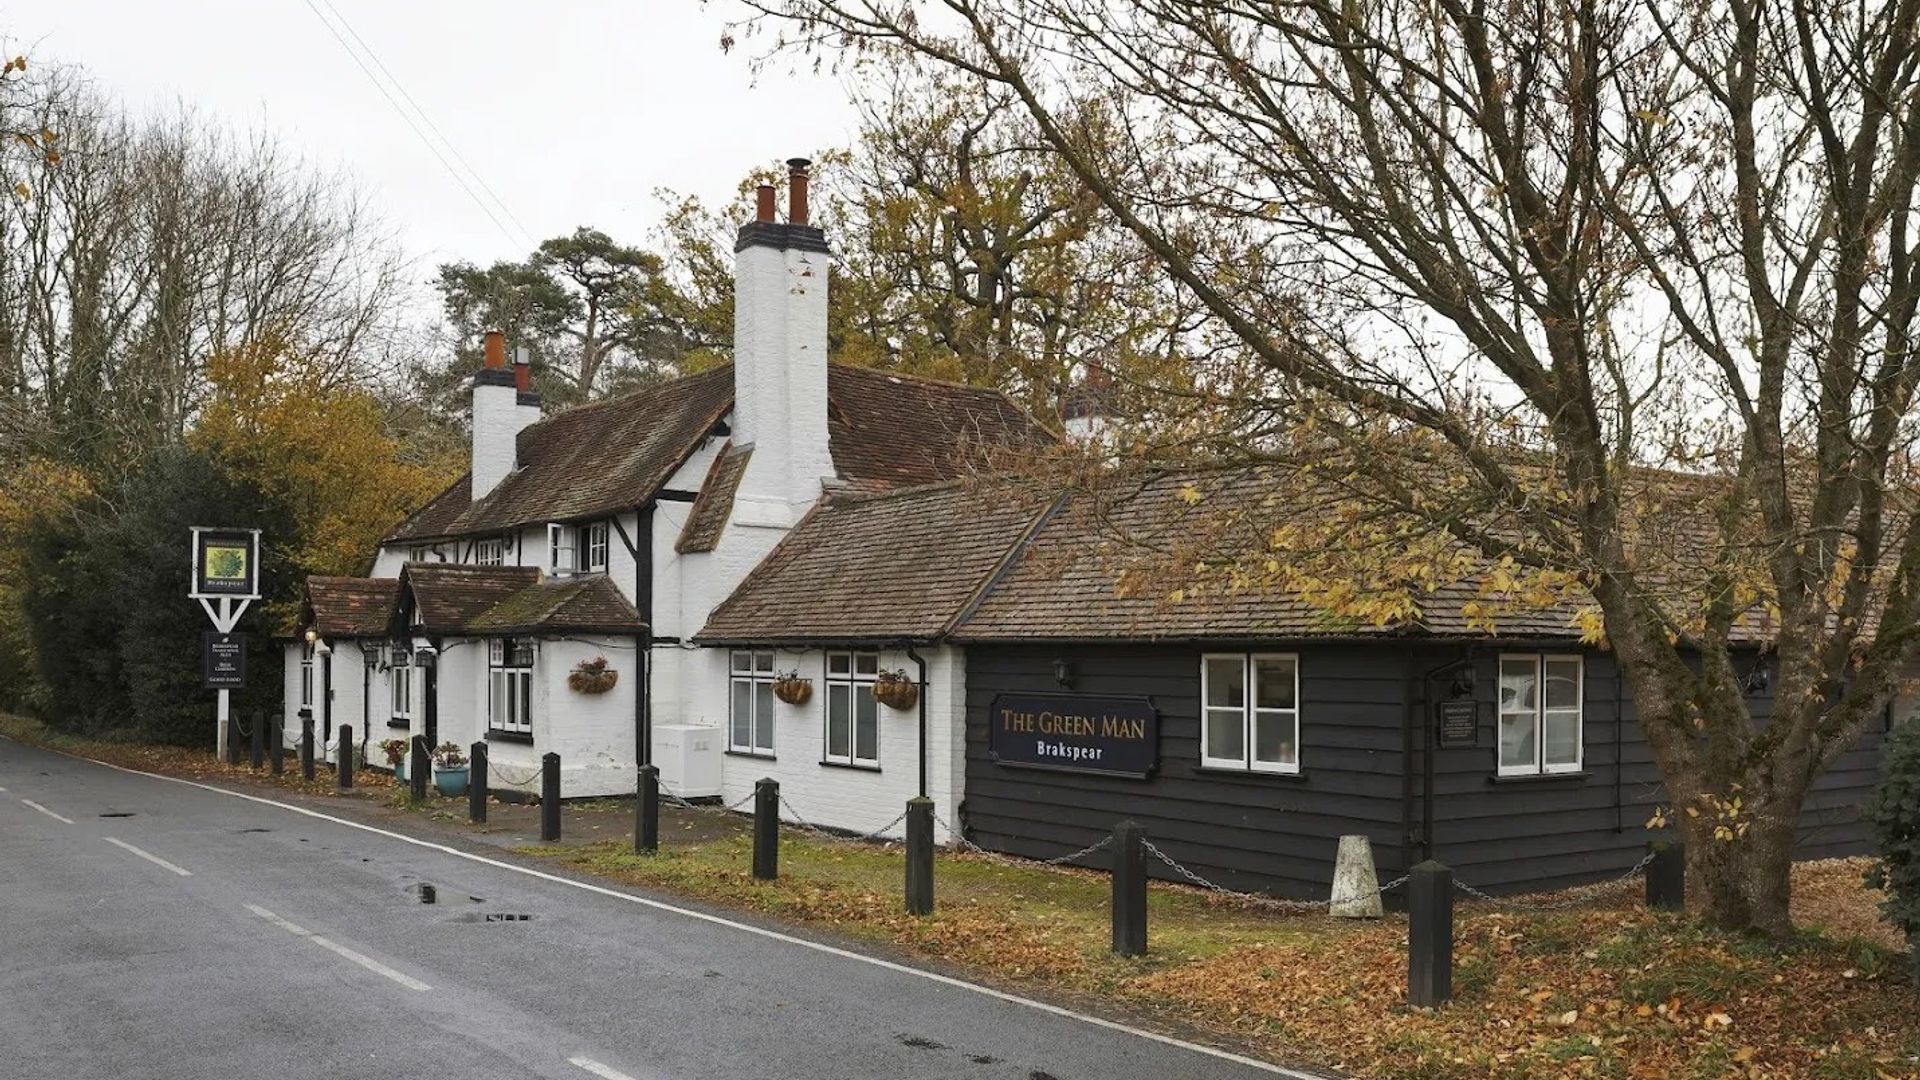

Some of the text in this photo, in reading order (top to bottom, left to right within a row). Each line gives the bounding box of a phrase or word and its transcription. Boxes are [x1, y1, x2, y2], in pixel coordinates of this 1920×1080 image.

[1001, 709, 1145, 740] THE GREEN MAN
[1037, 740, 1102, 761] Brakspear
